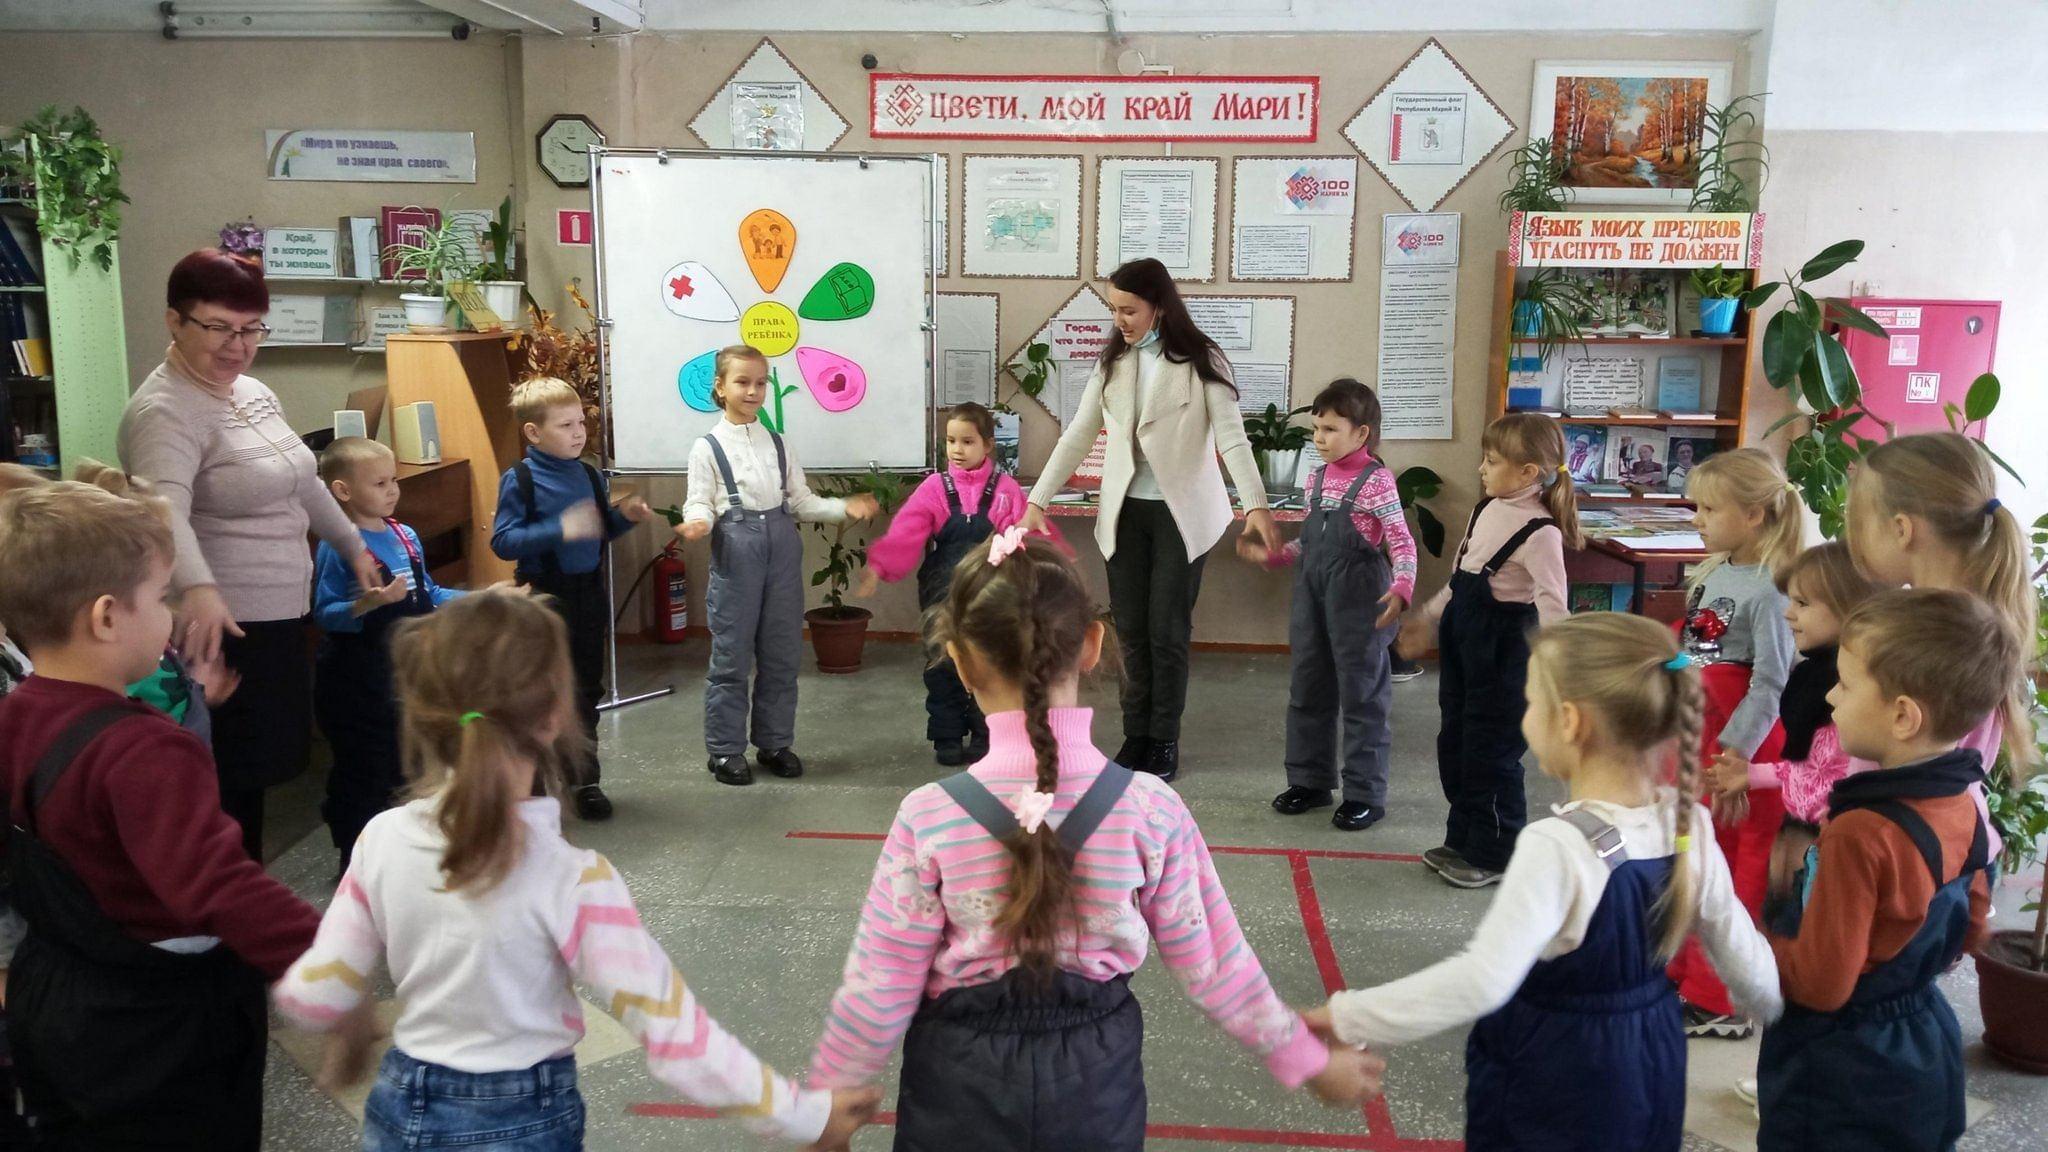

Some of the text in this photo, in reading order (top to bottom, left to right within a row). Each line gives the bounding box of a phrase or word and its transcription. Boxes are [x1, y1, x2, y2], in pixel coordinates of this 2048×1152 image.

[1321, 180, 1350, 190] 100
[1423, 234, 1444, 242] 100
[1629, 242, 1654, 260] НЕ
[752, 318, 786, 326] ПРАВА
[747, 330, 793, 339] РЕБЁНКА
[1055, 338, 1073, 346] что
[1915, 376, 1932, 388] ПК
